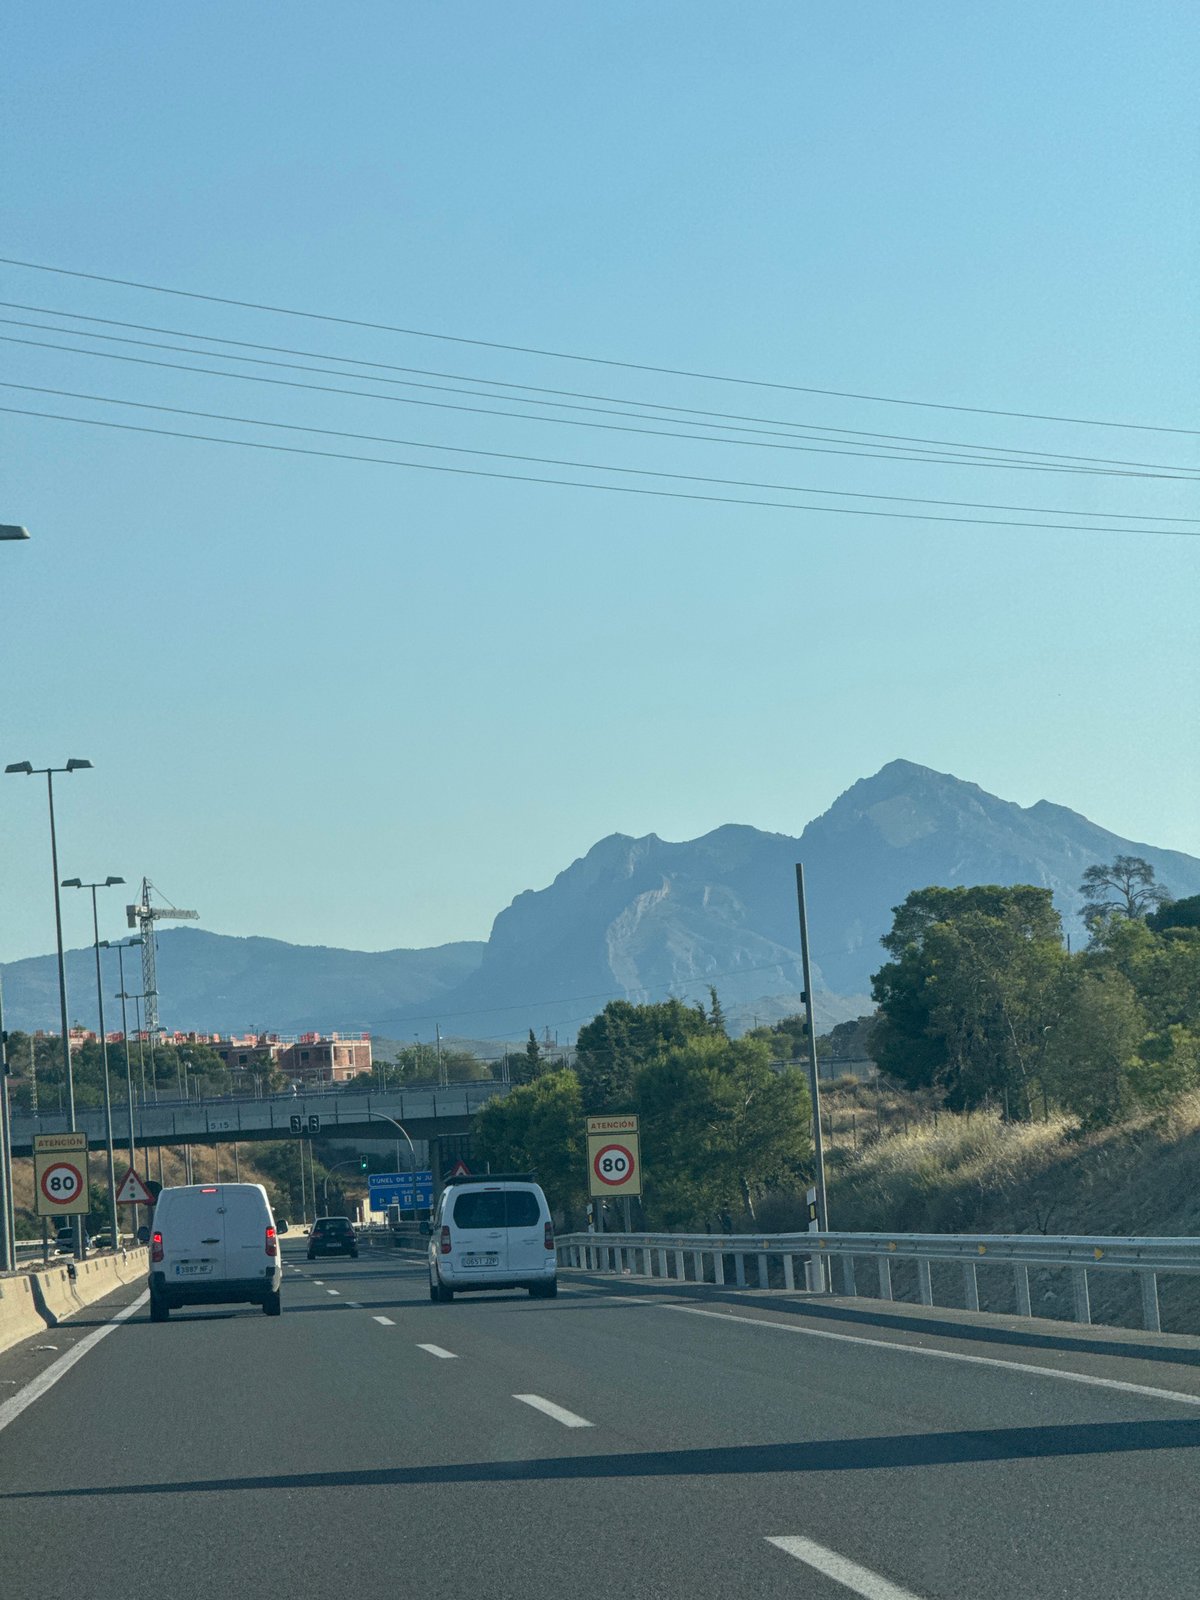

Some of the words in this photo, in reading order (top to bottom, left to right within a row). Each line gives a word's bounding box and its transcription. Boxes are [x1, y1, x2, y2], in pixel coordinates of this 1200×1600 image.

[591, 1120, 634, 1129] ATENCIÓN
[38, 1138, 83, 1147] ATENCIÓN
[603, 1158, 626, 1172] 80
[50, 1176, 74, 1191] 80
